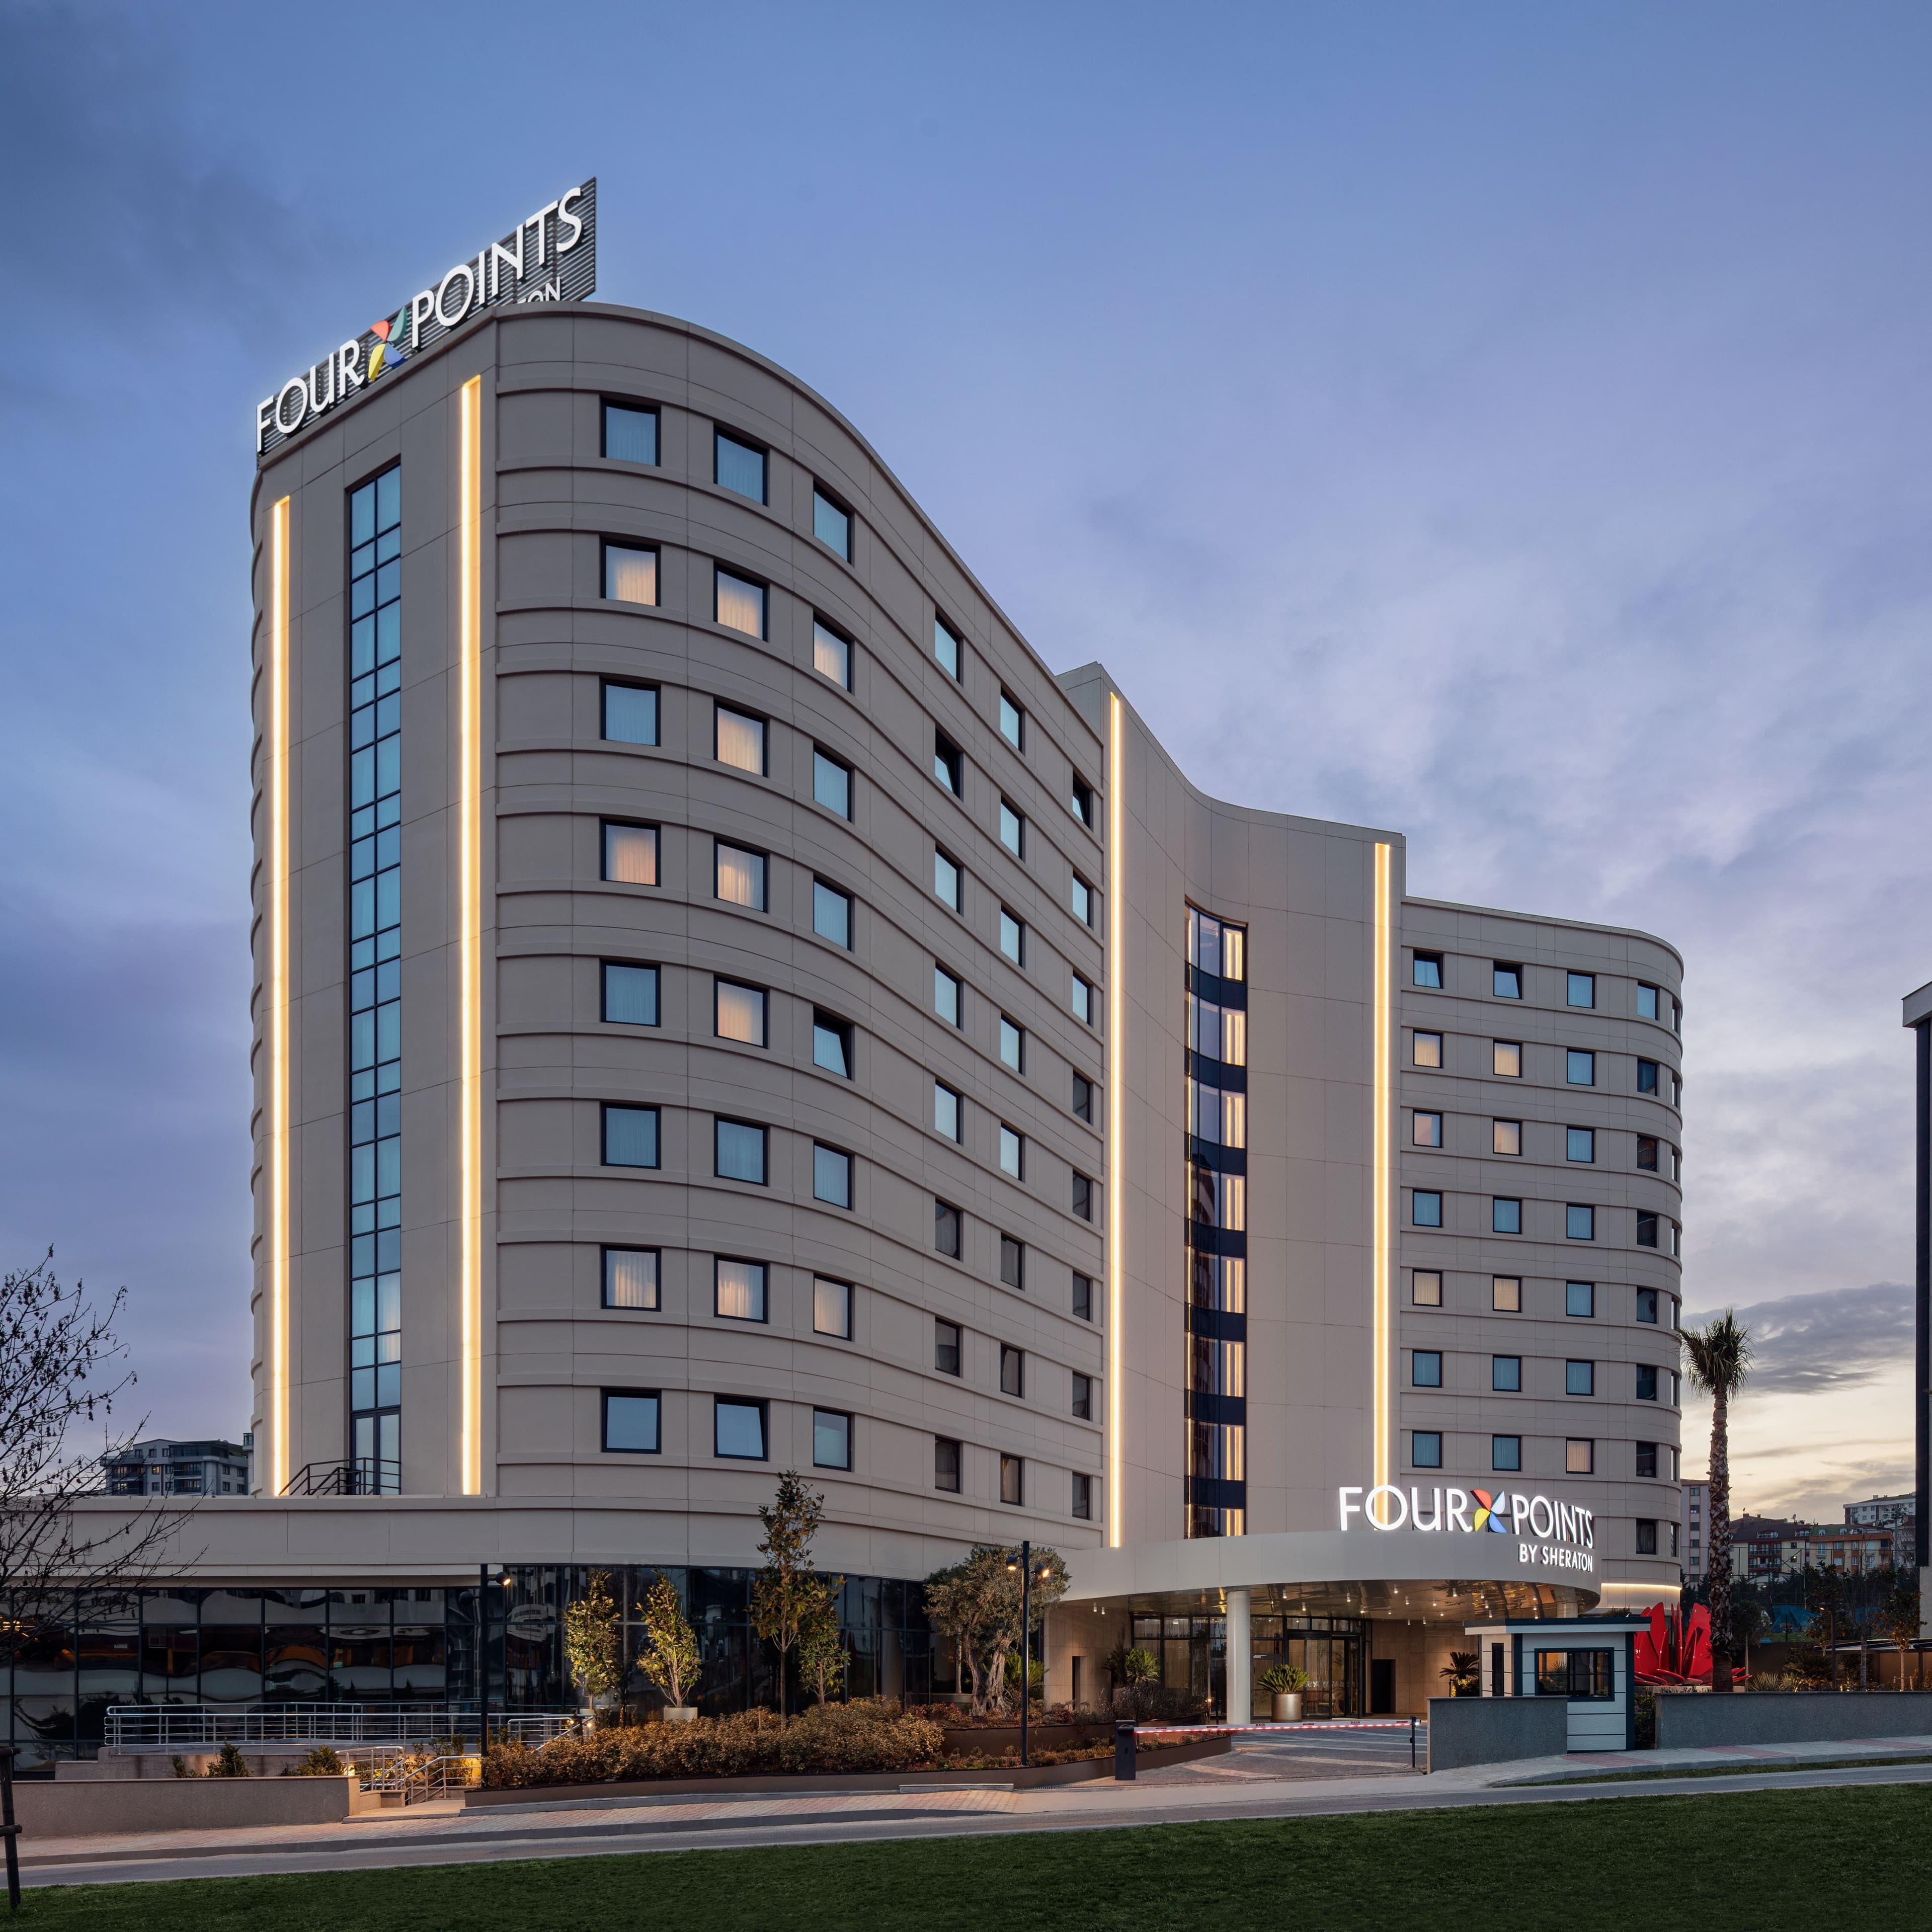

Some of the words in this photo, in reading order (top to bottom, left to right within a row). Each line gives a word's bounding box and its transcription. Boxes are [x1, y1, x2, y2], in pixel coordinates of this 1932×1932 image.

[257, 339, 364, 453] FOUR
[411, 187, 582, 349] POINTS
[1339, 1484, 1473, 1532] FOUR
[1510, 1494, 1594, 1549] POINTS
[1518, 1544, 1538, 1563] BY
[1541, 1546, 1593, 1573] SHERATON
